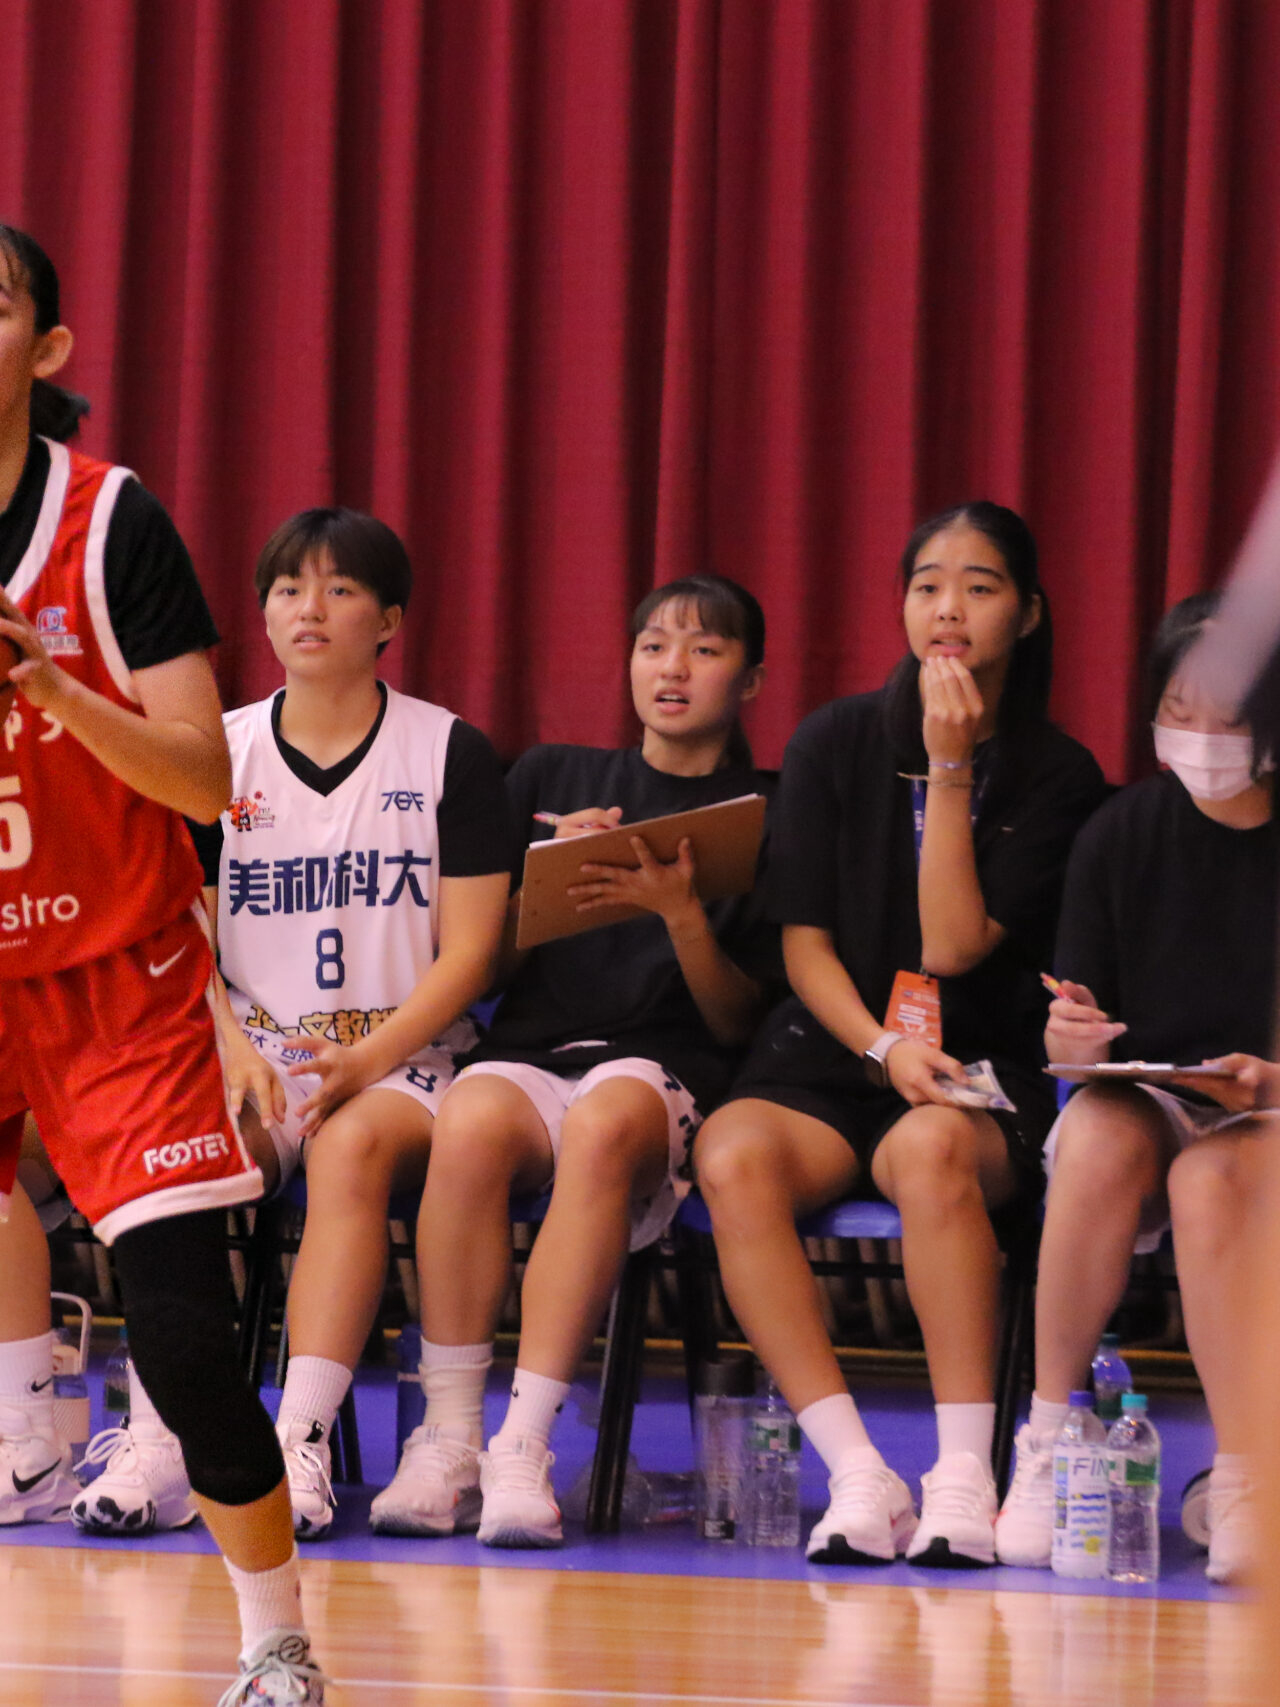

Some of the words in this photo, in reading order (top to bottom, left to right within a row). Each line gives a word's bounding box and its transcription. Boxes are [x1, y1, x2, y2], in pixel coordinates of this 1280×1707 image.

[229, 850, 432, 916] 美和科大
[316, 928, 345, 990] 8
[143, 1132, 230, 1176] FOOTER
